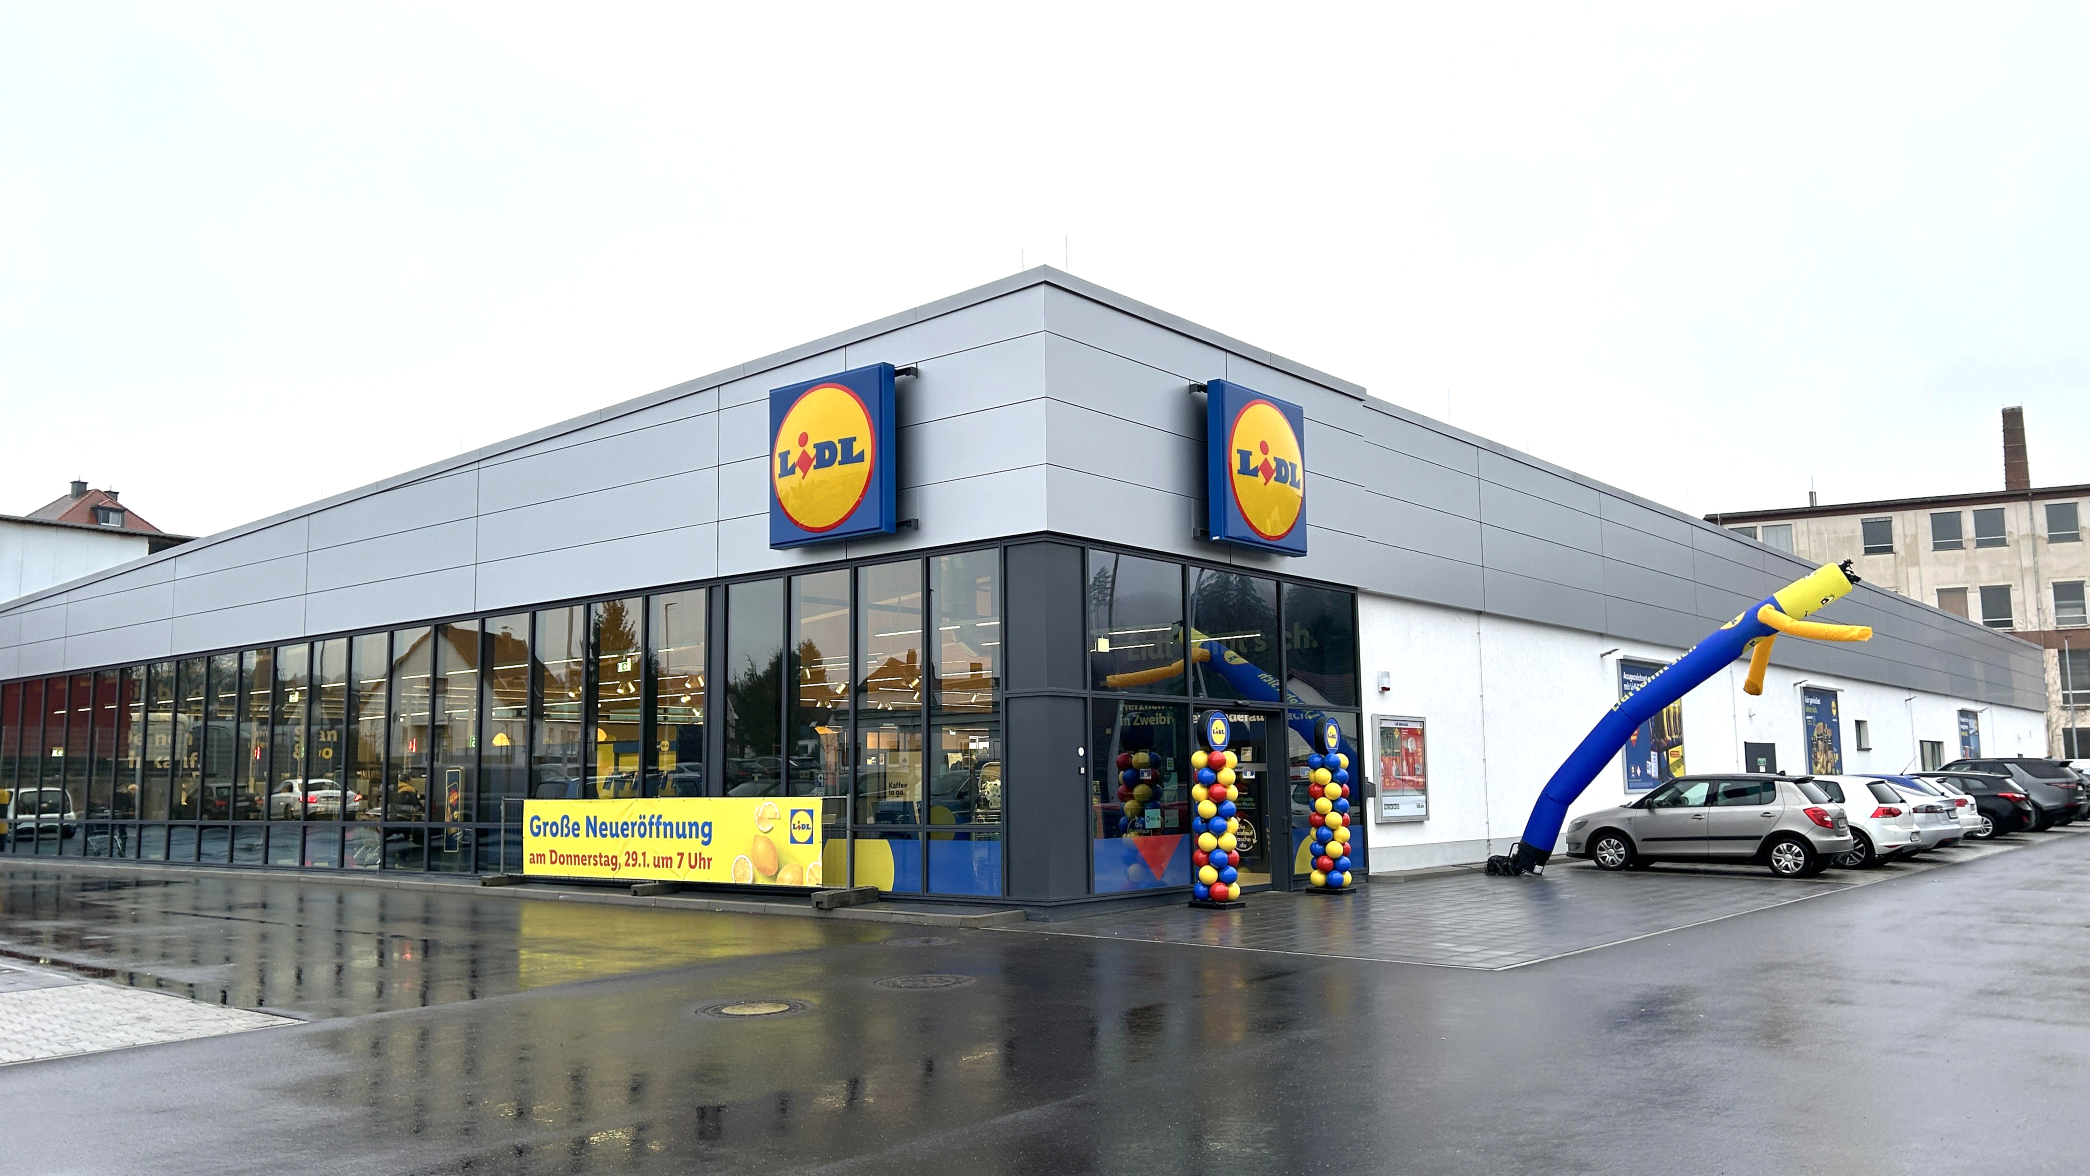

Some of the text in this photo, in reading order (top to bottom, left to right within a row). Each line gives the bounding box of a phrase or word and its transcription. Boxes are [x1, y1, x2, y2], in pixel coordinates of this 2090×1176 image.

[1132, 712, 1174, 726] Zweibr
[888, 781, 908, 789] Kaffee
[529, 814, 713, 846] Große Neueröffnung
[529, 849, 713, 872] am Donnerstag, 29.1. um 7 Uhr
